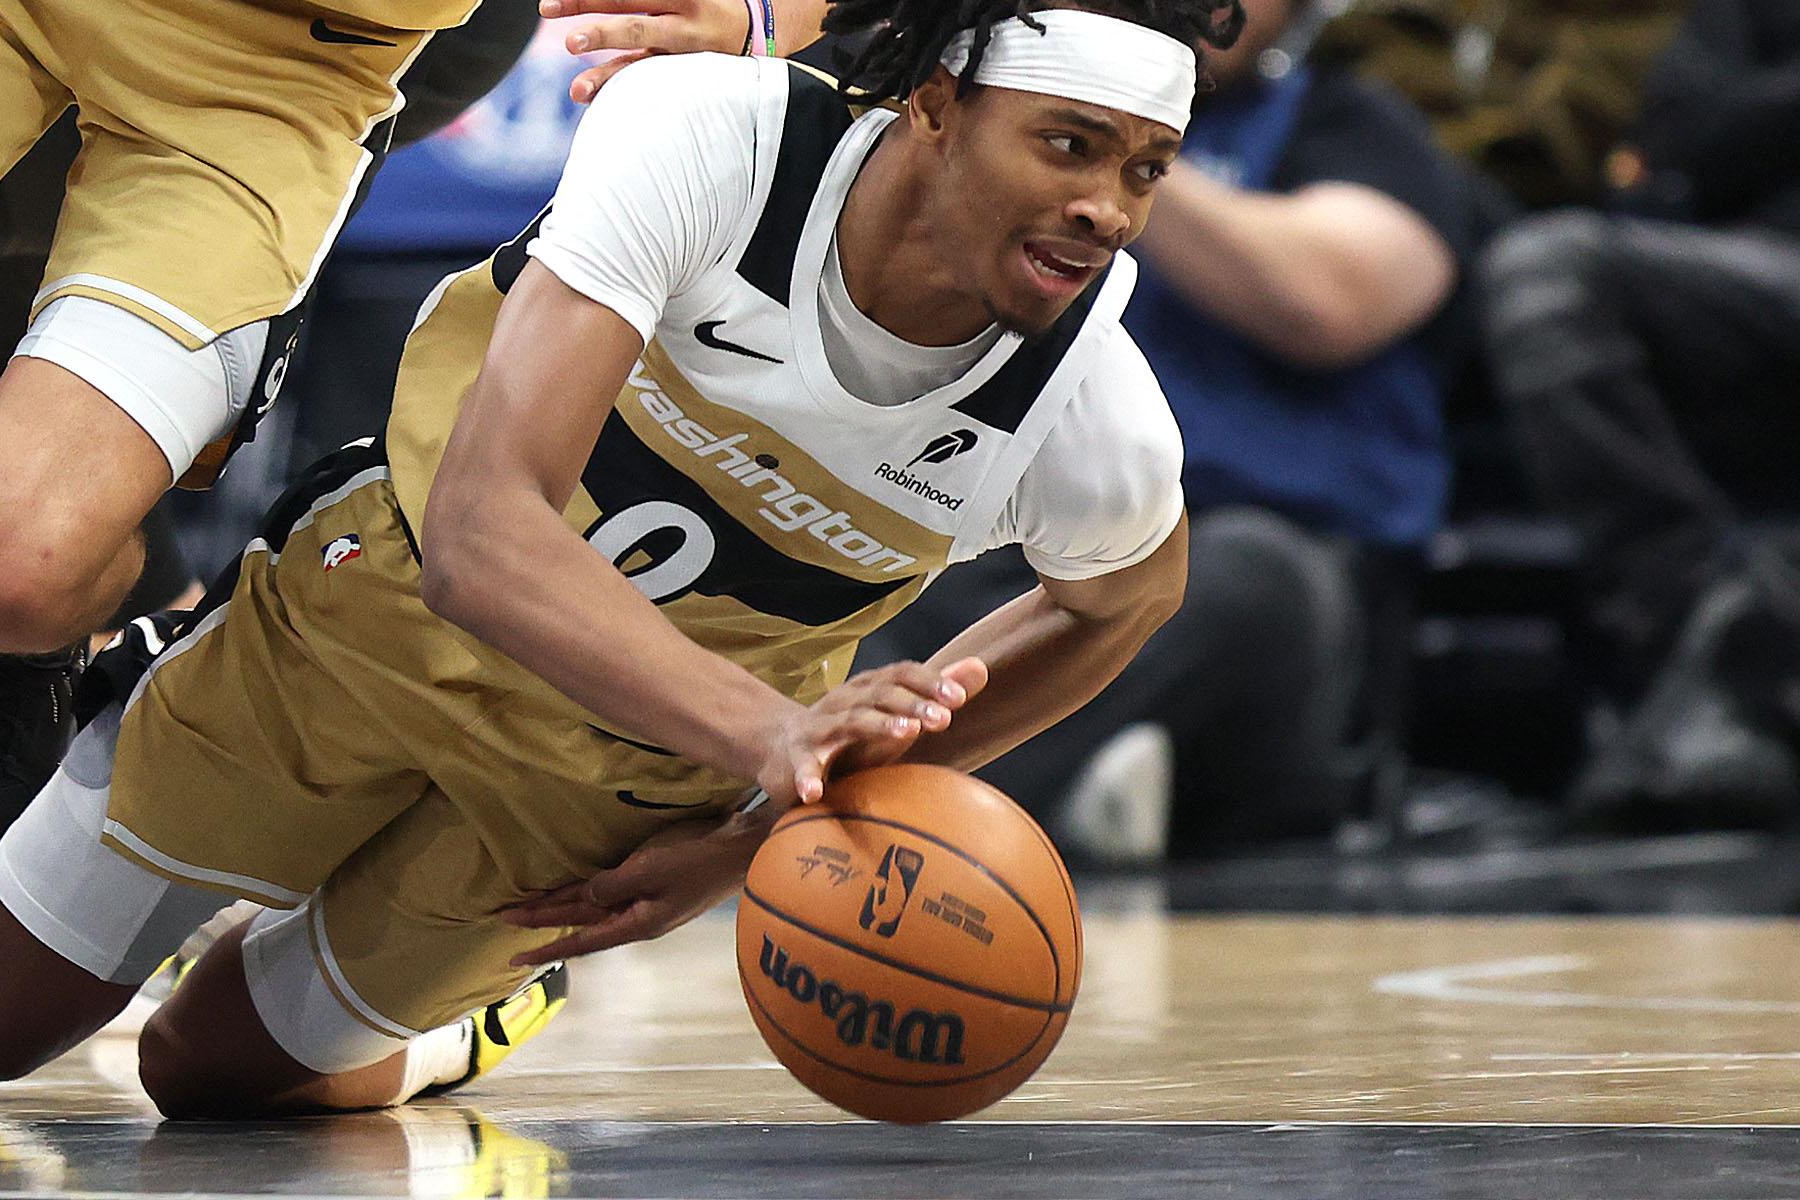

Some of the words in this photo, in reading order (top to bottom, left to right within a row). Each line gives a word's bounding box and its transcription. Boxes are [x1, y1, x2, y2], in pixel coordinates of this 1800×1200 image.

[873, 461, 965, 513] Robinhood
[586, 499, 717, 602] 0
[758, 931, 966, 1065] Wilson
